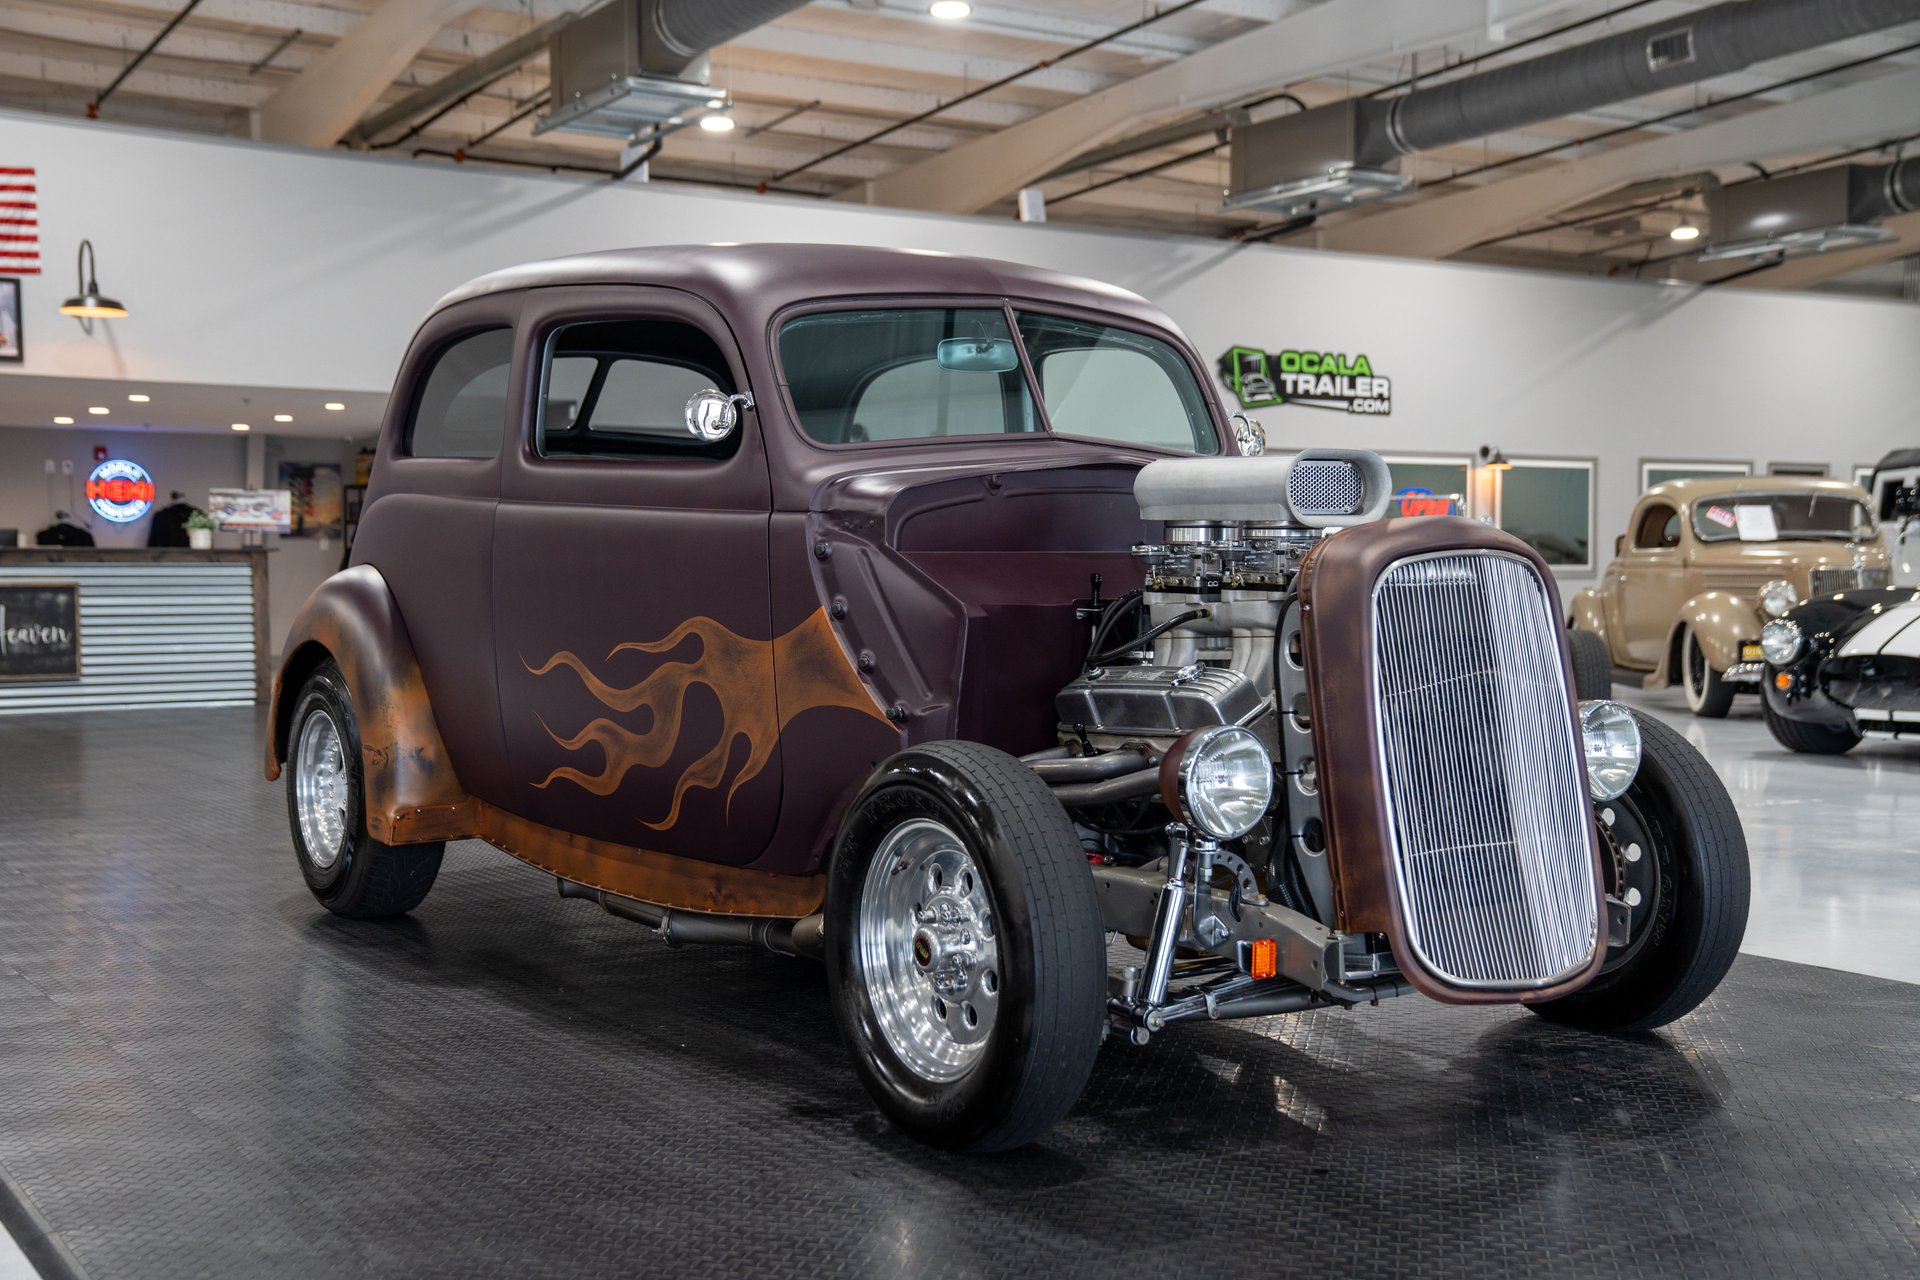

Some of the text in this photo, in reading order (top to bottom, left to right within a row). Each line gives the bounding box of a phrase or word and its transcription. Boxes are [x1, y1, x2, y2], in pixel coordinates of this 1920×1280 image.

[1280, 351, 1372, 376] OCALA
[1280, 373, 1390, 398] TRAILER
[1348, 398, 1389, 413] .COM
[86, 479, 155, 502] HEMI
